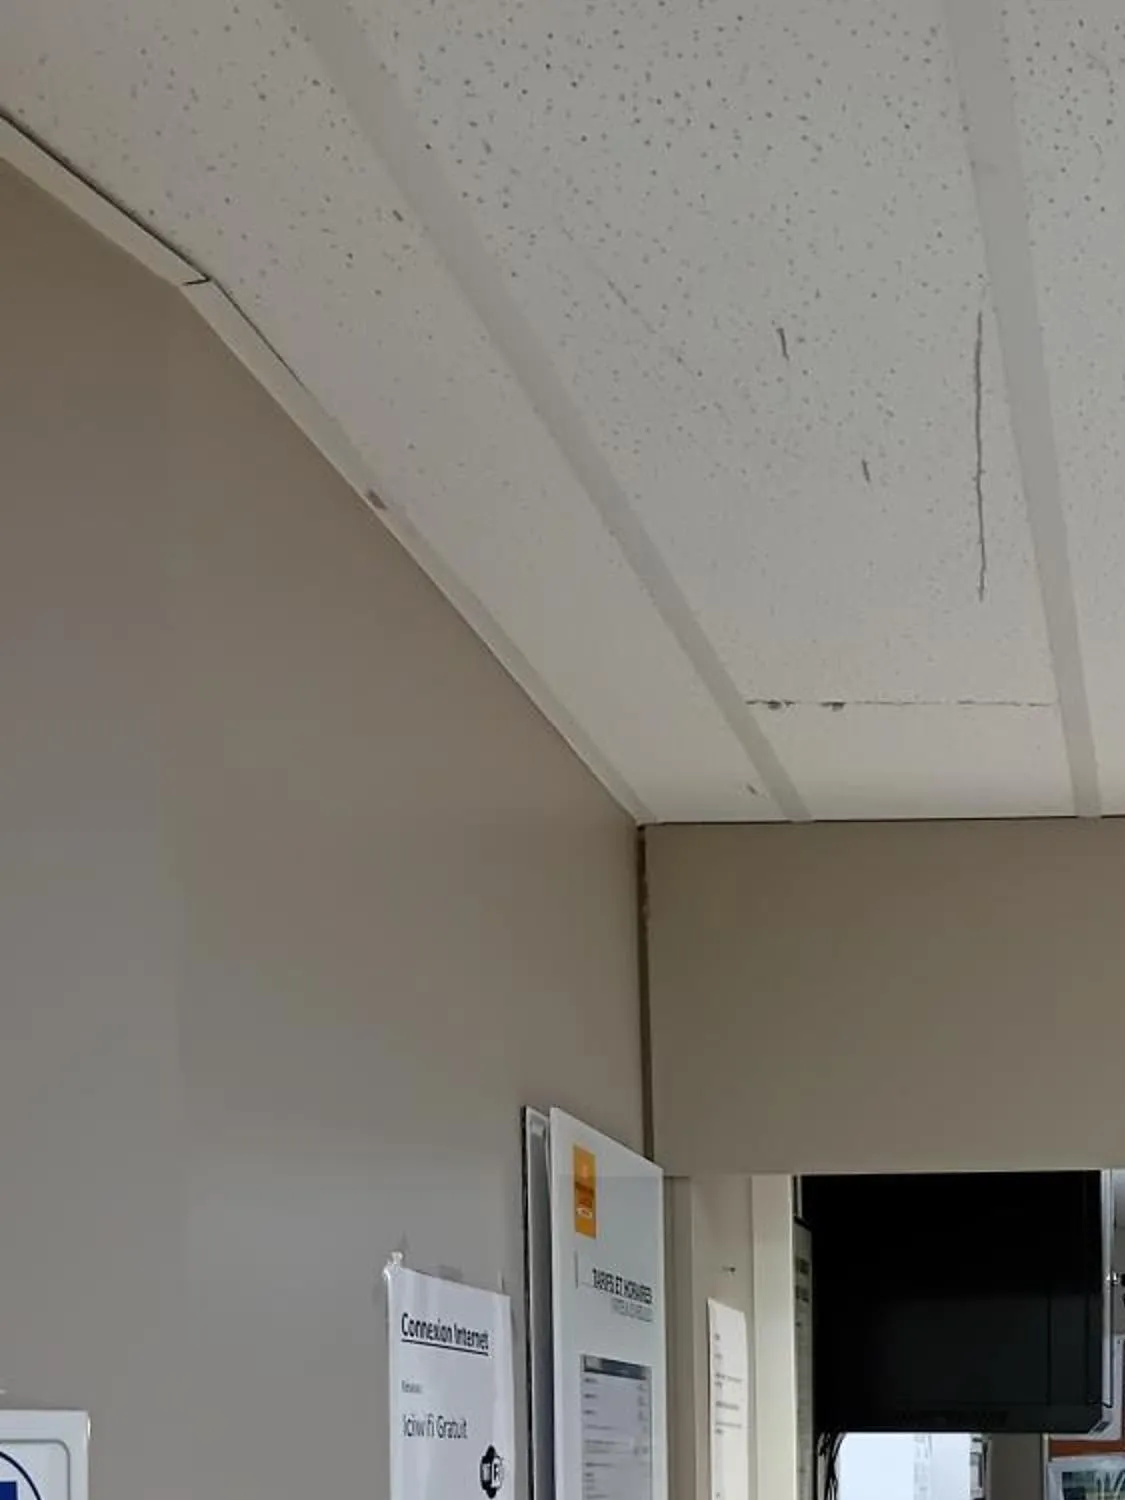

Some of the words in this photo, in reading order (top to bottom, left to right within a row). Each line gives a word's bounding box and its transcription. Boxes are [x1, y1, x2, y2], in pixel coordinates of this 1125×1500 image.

[401, 1312, 452, 1344] Connexion
[453, 1325, 489, 1350] Internet
[436, 1415, 468, 1439] Gratuit
